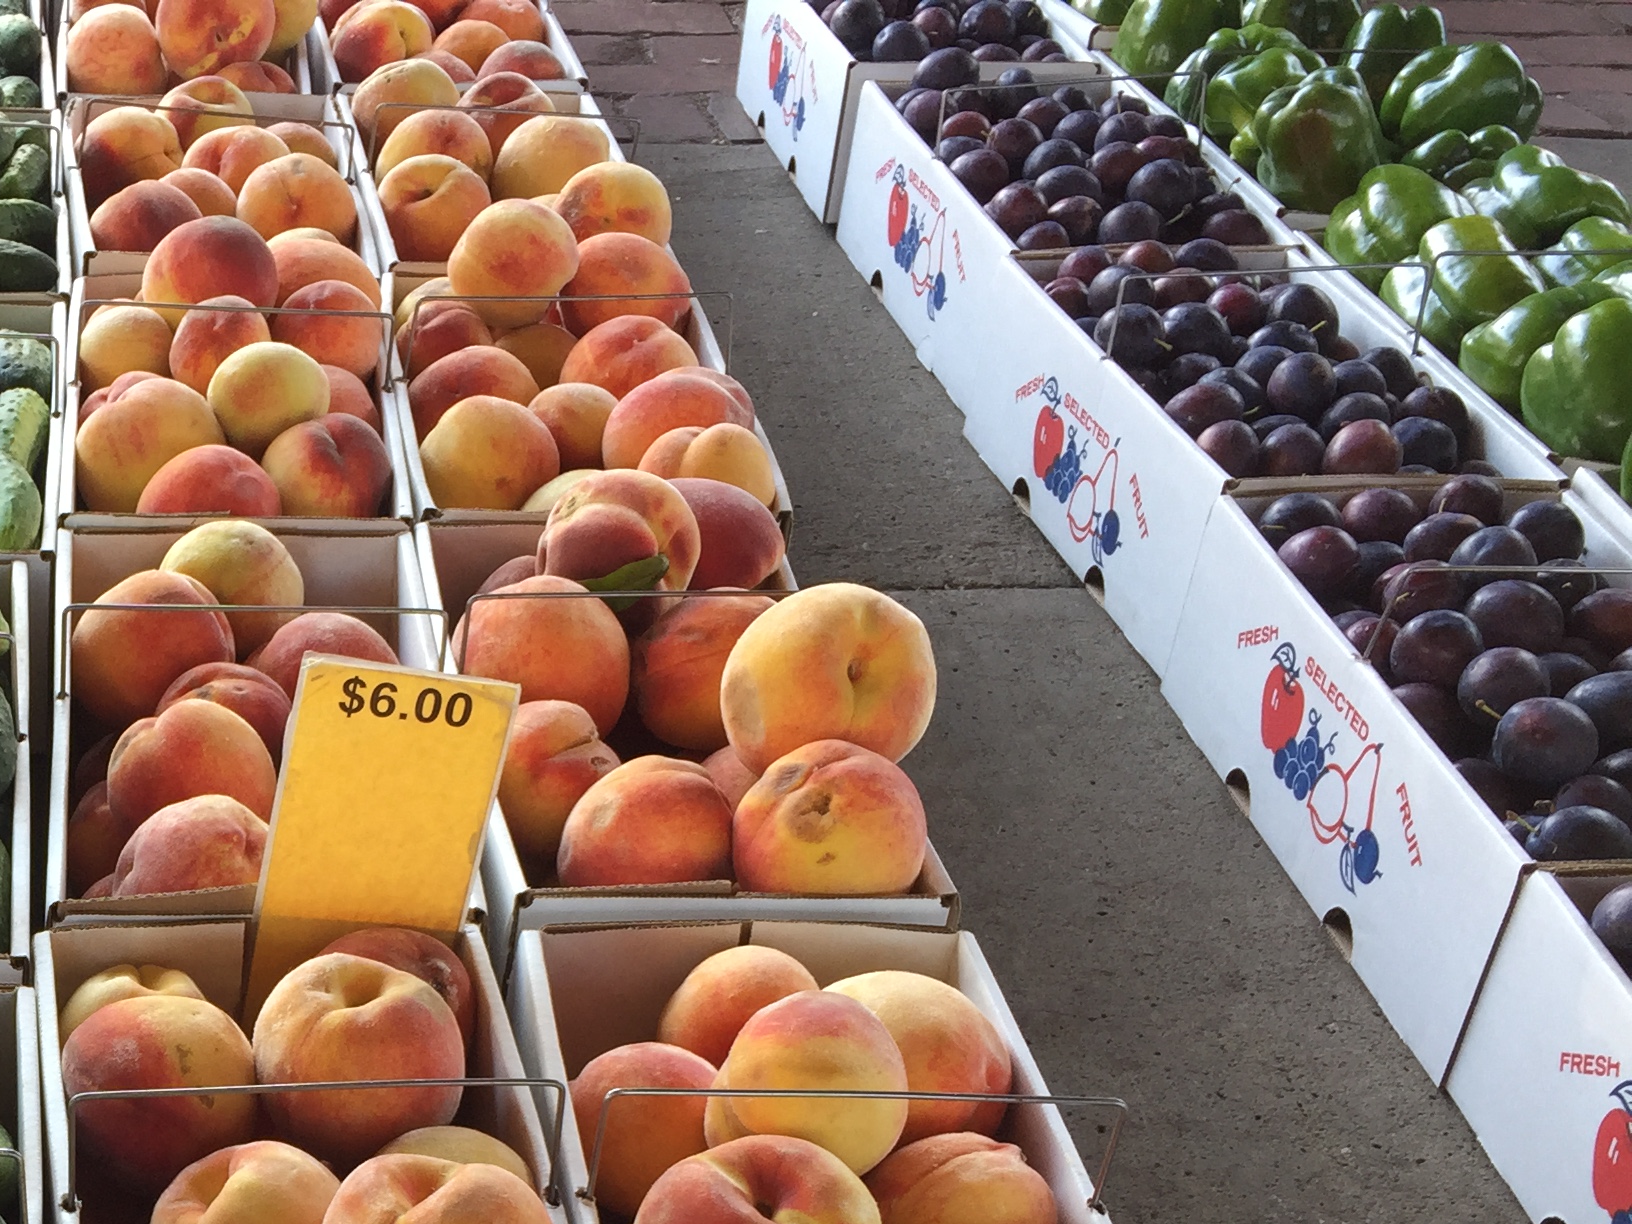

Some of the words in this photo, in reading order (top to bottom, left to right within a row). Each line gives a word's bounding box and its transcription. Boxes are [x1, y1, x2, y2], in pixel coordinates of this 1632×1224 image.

[908, 168, 941, 212] SELECTED
[1015, 373, 1045, 403] FRESH
[1063, 392, 1110, 449] SELECTED
[1129, 473, 1149, 539] FRUIT
[338, 676, 473, 728] $6.00
[1237, 625, 1279, 649] FRESH
[1304, 656, 1370, 742] SELECTED
[1396, 782, 1422, 867] FRUIT
[1559, 1052, 1620, 1078] FRESH
